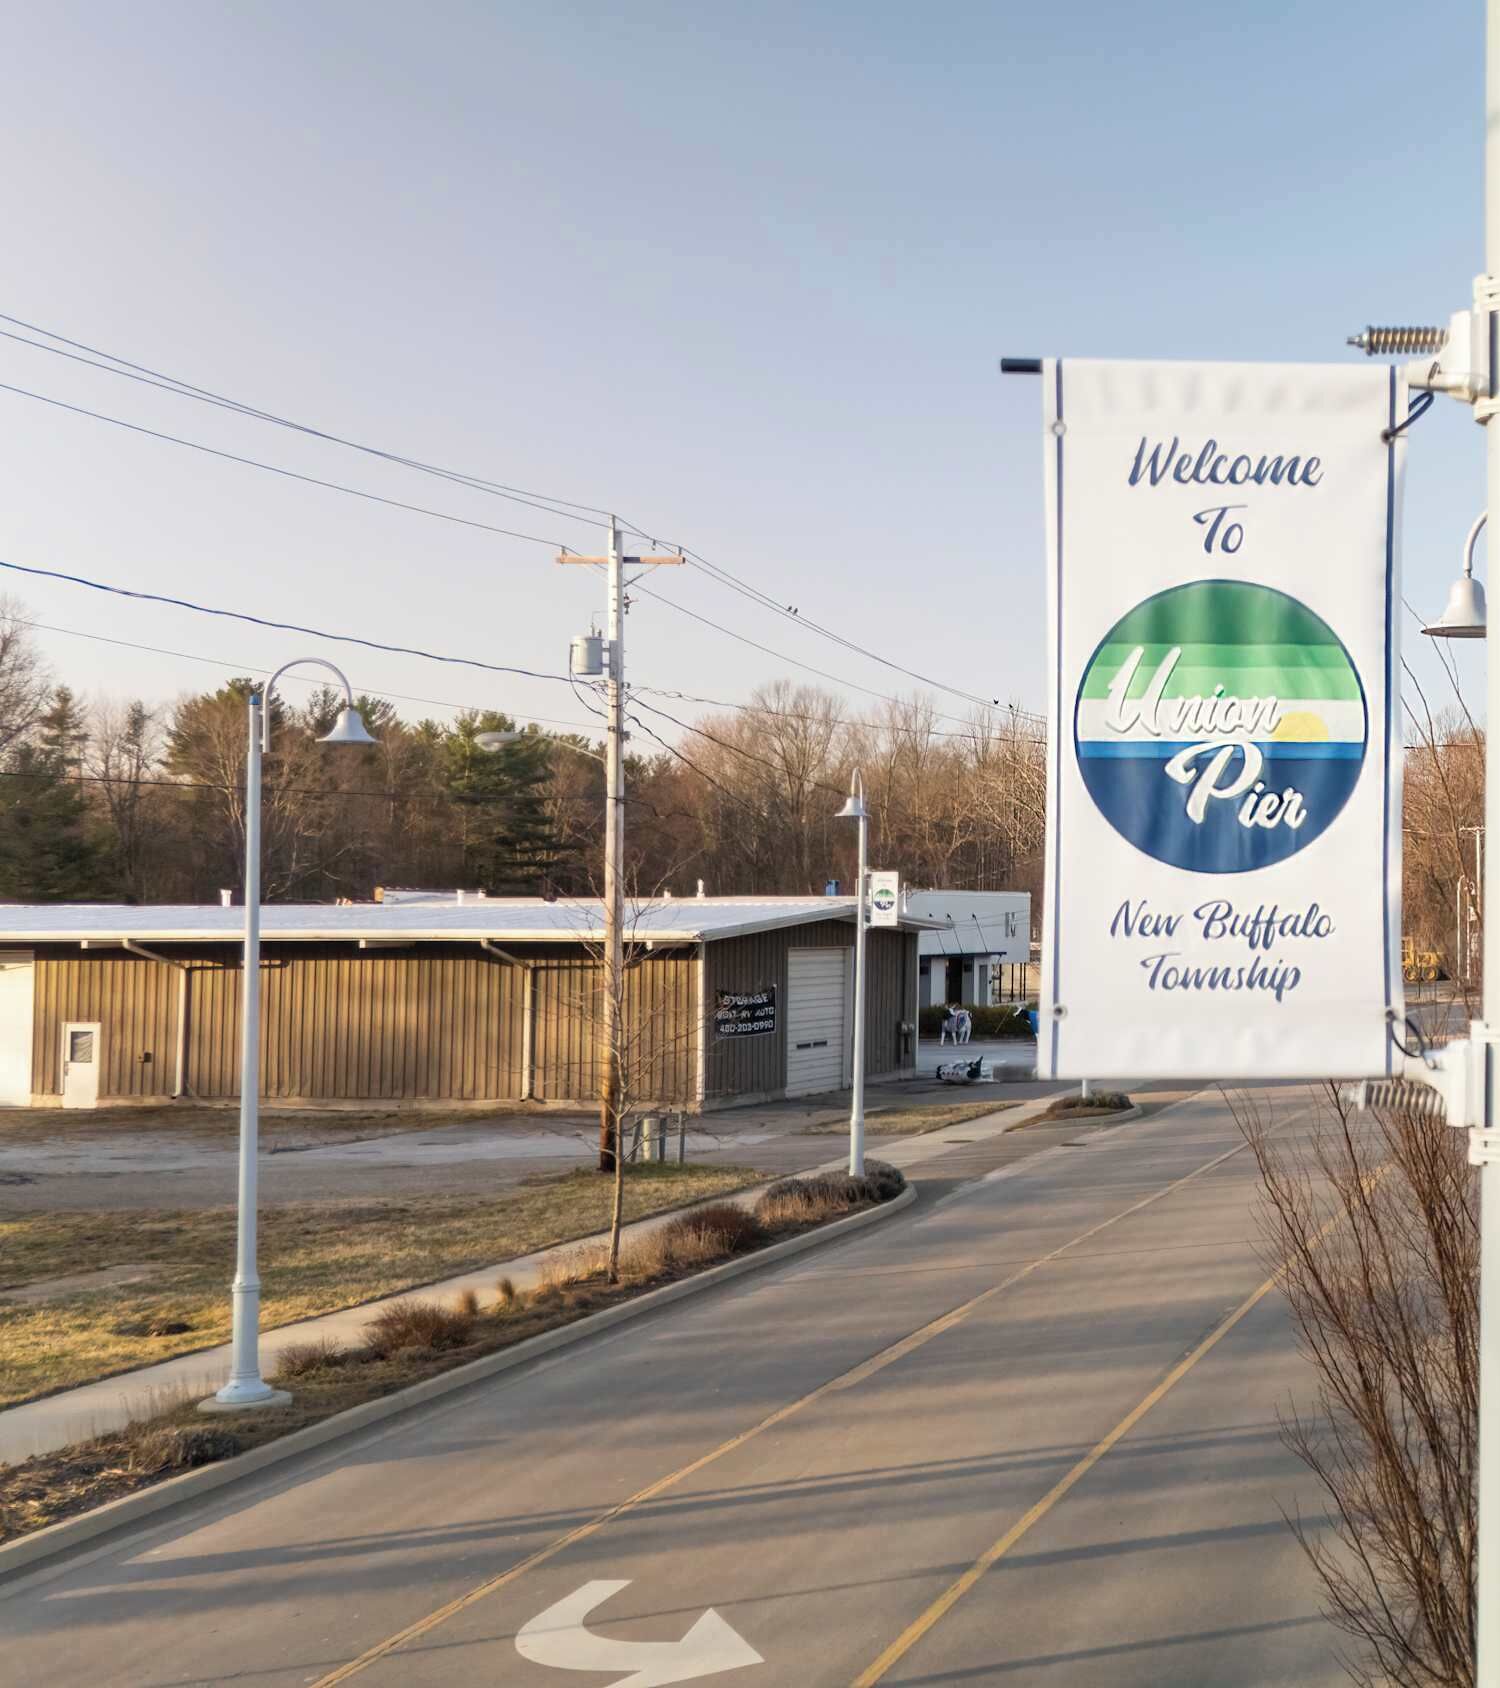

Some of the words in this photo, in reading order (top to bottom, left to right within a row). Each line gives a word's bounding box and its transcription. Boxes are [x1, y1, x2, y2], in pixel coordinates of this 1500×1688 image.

[1127, 436, 1324, 487] Welcome
[1192, 504, 1248, 554] To
[1104, 645, 1282, 737] Union
[1164, 740, 1307, 829] Pier
[1109, 899, 1184, 938] New
[1193, 900, 1336, 951] Buffalo
[1140, 954, 1302, 1003] Township
[755, 1006, 775, 1017] AUTO
